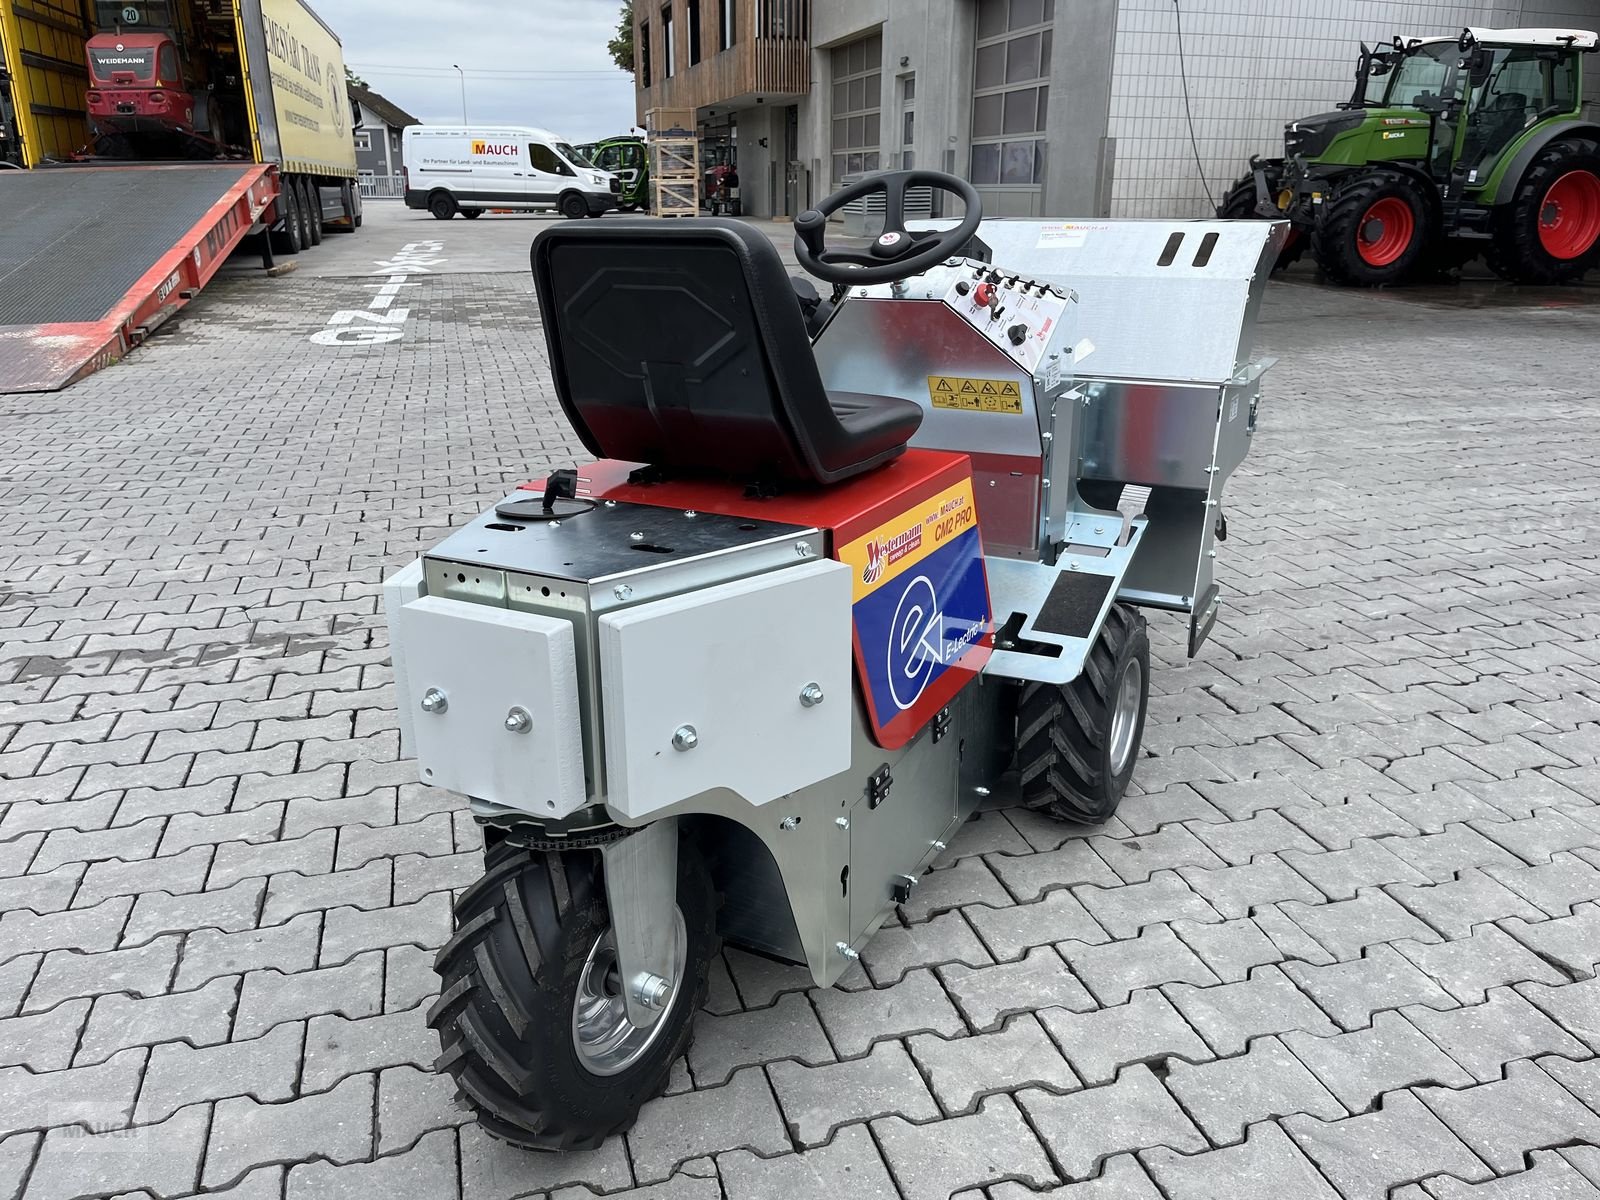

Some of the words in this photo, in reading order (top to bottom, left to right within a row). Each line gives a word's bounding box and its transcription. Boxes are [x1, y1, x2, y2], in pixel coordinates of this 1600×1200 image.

[125, 9, 137, 21] 20
[475, 144, 518, 156] MAUCH
[158, 277, 174, 302] BUTT
[935, 517, 954, 542] CM2
[954, 505, 972, 531] PRO
[866, 523, 922, 572] Westermann
[889, 548, 904, 563] sweep
[945, 622, 979, 661] E-Lectric
